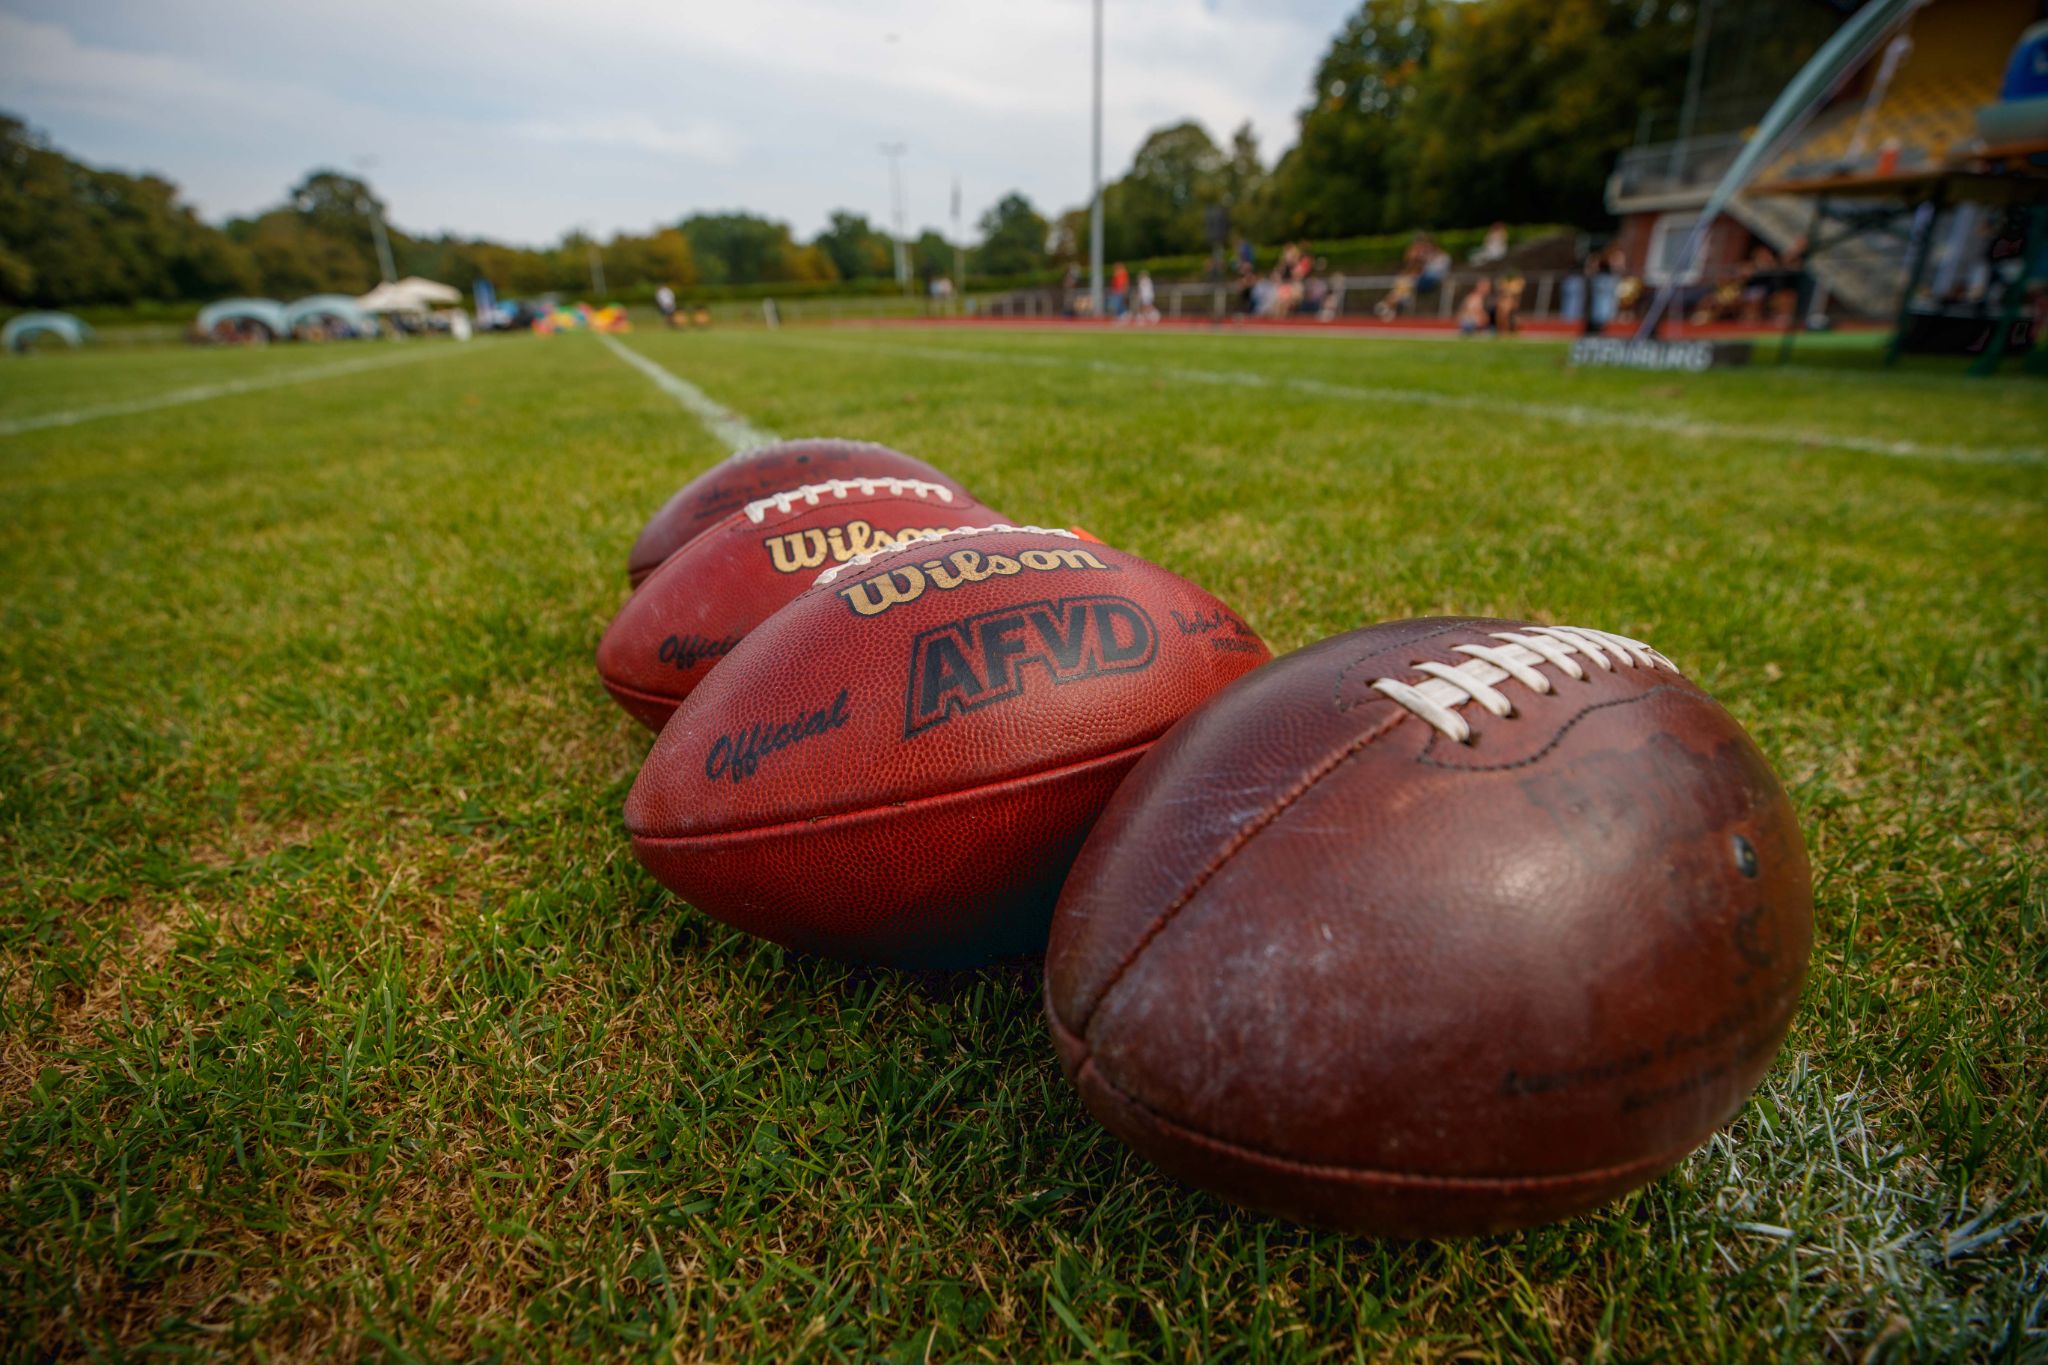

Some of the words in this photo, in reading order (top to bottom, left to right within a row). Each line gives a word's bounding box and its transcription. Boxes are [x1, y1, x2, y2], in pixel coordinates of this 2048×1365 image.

[763, 518, 952, 575] Wilso
[836, 548, 1108, 617] Wilson
[904, 594, 1159, 741] AFVD
[705, 688, 849, 784] Official
